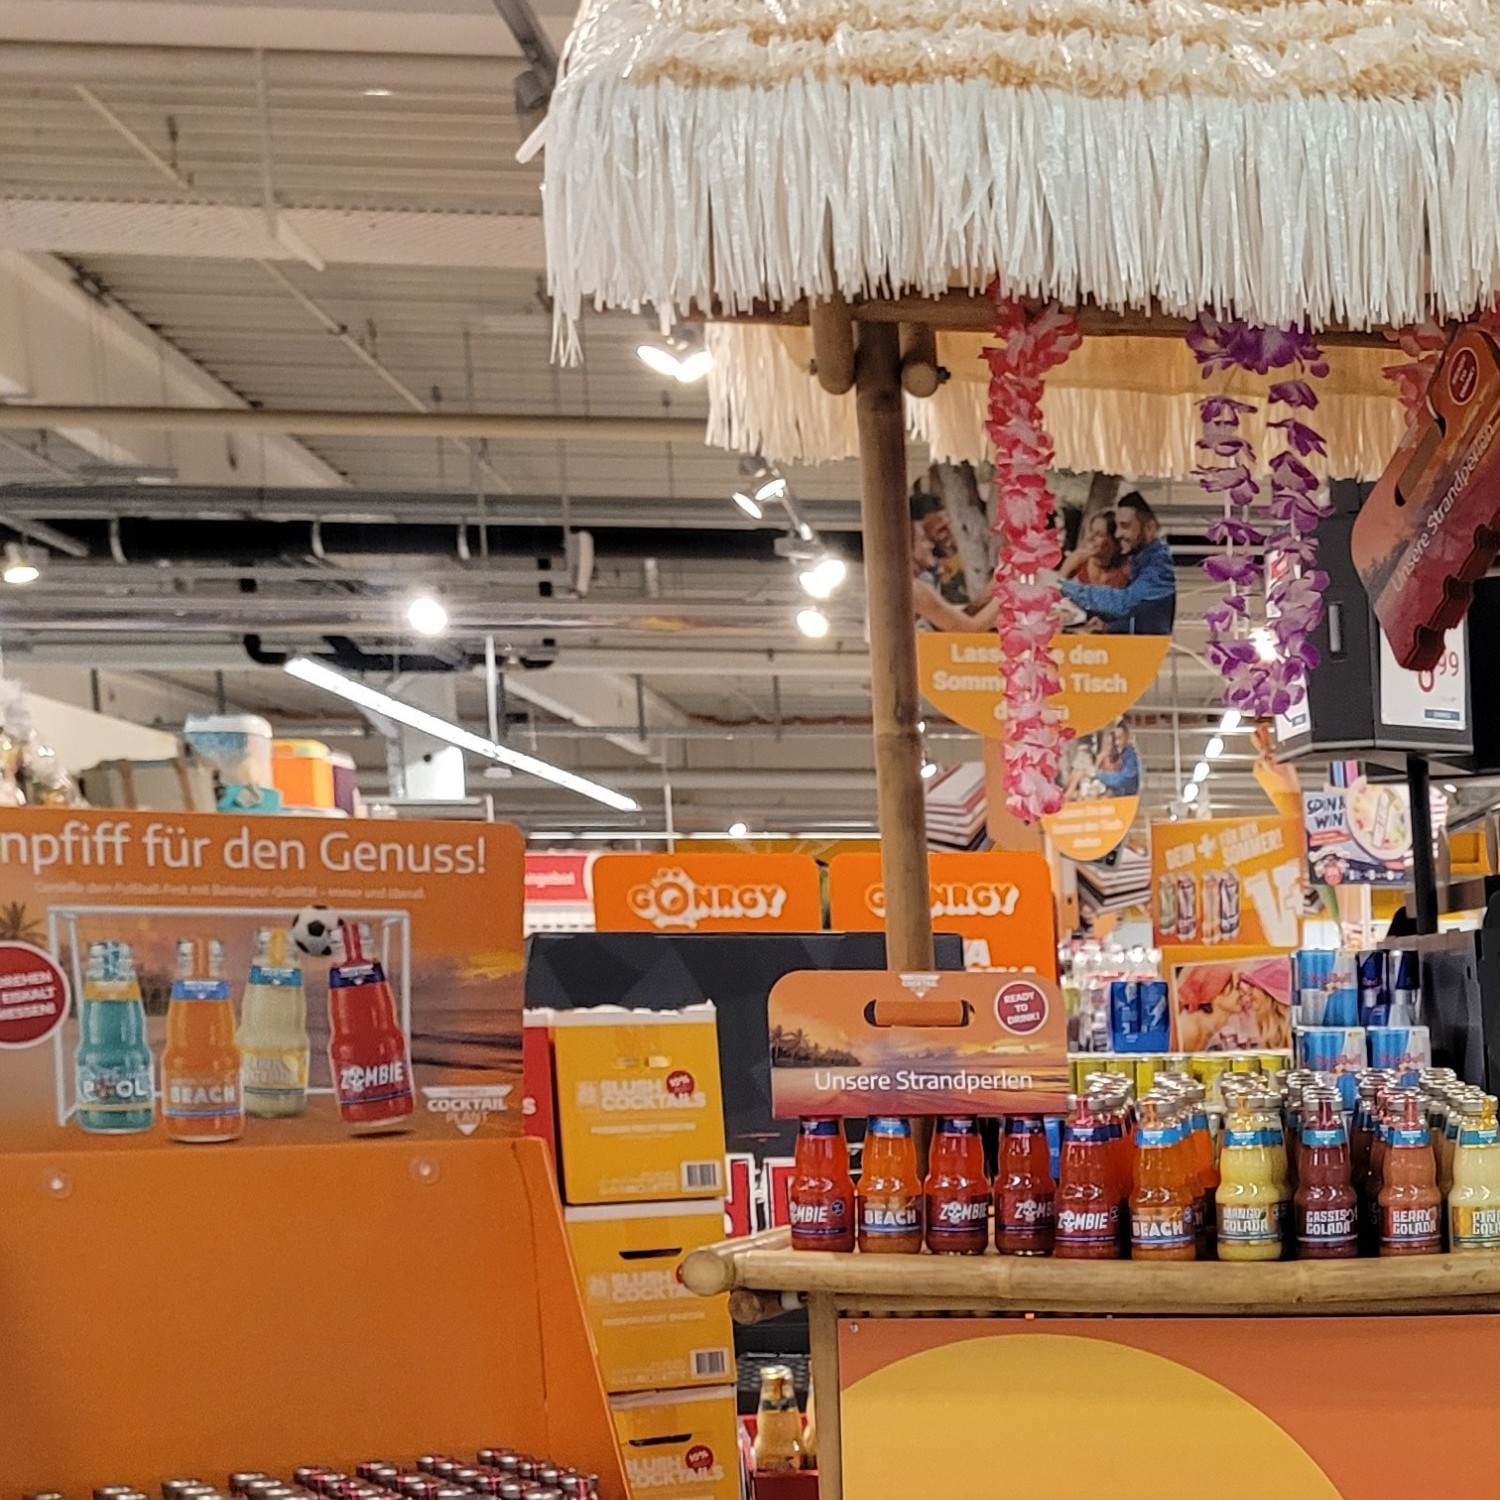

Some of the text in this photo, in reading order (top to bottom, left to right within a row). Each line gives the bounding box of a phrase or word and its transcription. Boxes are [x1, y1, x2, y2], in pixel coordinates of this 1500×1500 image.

[1391, 424, 1495, 591] Unsere Strandperlen
[1069, 645, 1108, 665] den
[1071, 673, 1128, 692] Tisch
[1315, 814, 1343, 828] WIN
[143, 823, 210, 870] für
[223, 827, 306, 872] den
[320, 830, 487, 875] Genuss!
[1003, 991, 1035, 1004] READY
[1014, 1003, 1028, 1012] TO
[1007, 1012, 1040, 1026] DRINK!
[338, 1060, 405, 1092] ZOMBIE
[814, 1068, 1034, 1095] Unsere Strandperlen
[426, 1097, 508, 1113] COCKTAIL
[790, 1202, 829, 1225] MBIE
[864, 1208, 917, 1225] BEACH
[938, 1200, 988, 1224] ZOMBIE
[1014, 1200, 1053, 1224] ZOMB
[1057, 1209, 1109, 1232] ZOMBIE
[1222, 1207, 1263, 1220] MANGO
[1306, 1208, 1347, 1223] CASSIS
[1392, 1209, 1431, 1223] BERRY
[1132, 1219, 1184, 1237] BEACH
[1306, 1221, 1350, 1235] COLADA
[1392, 1222, 1437, 1235] COLADA
